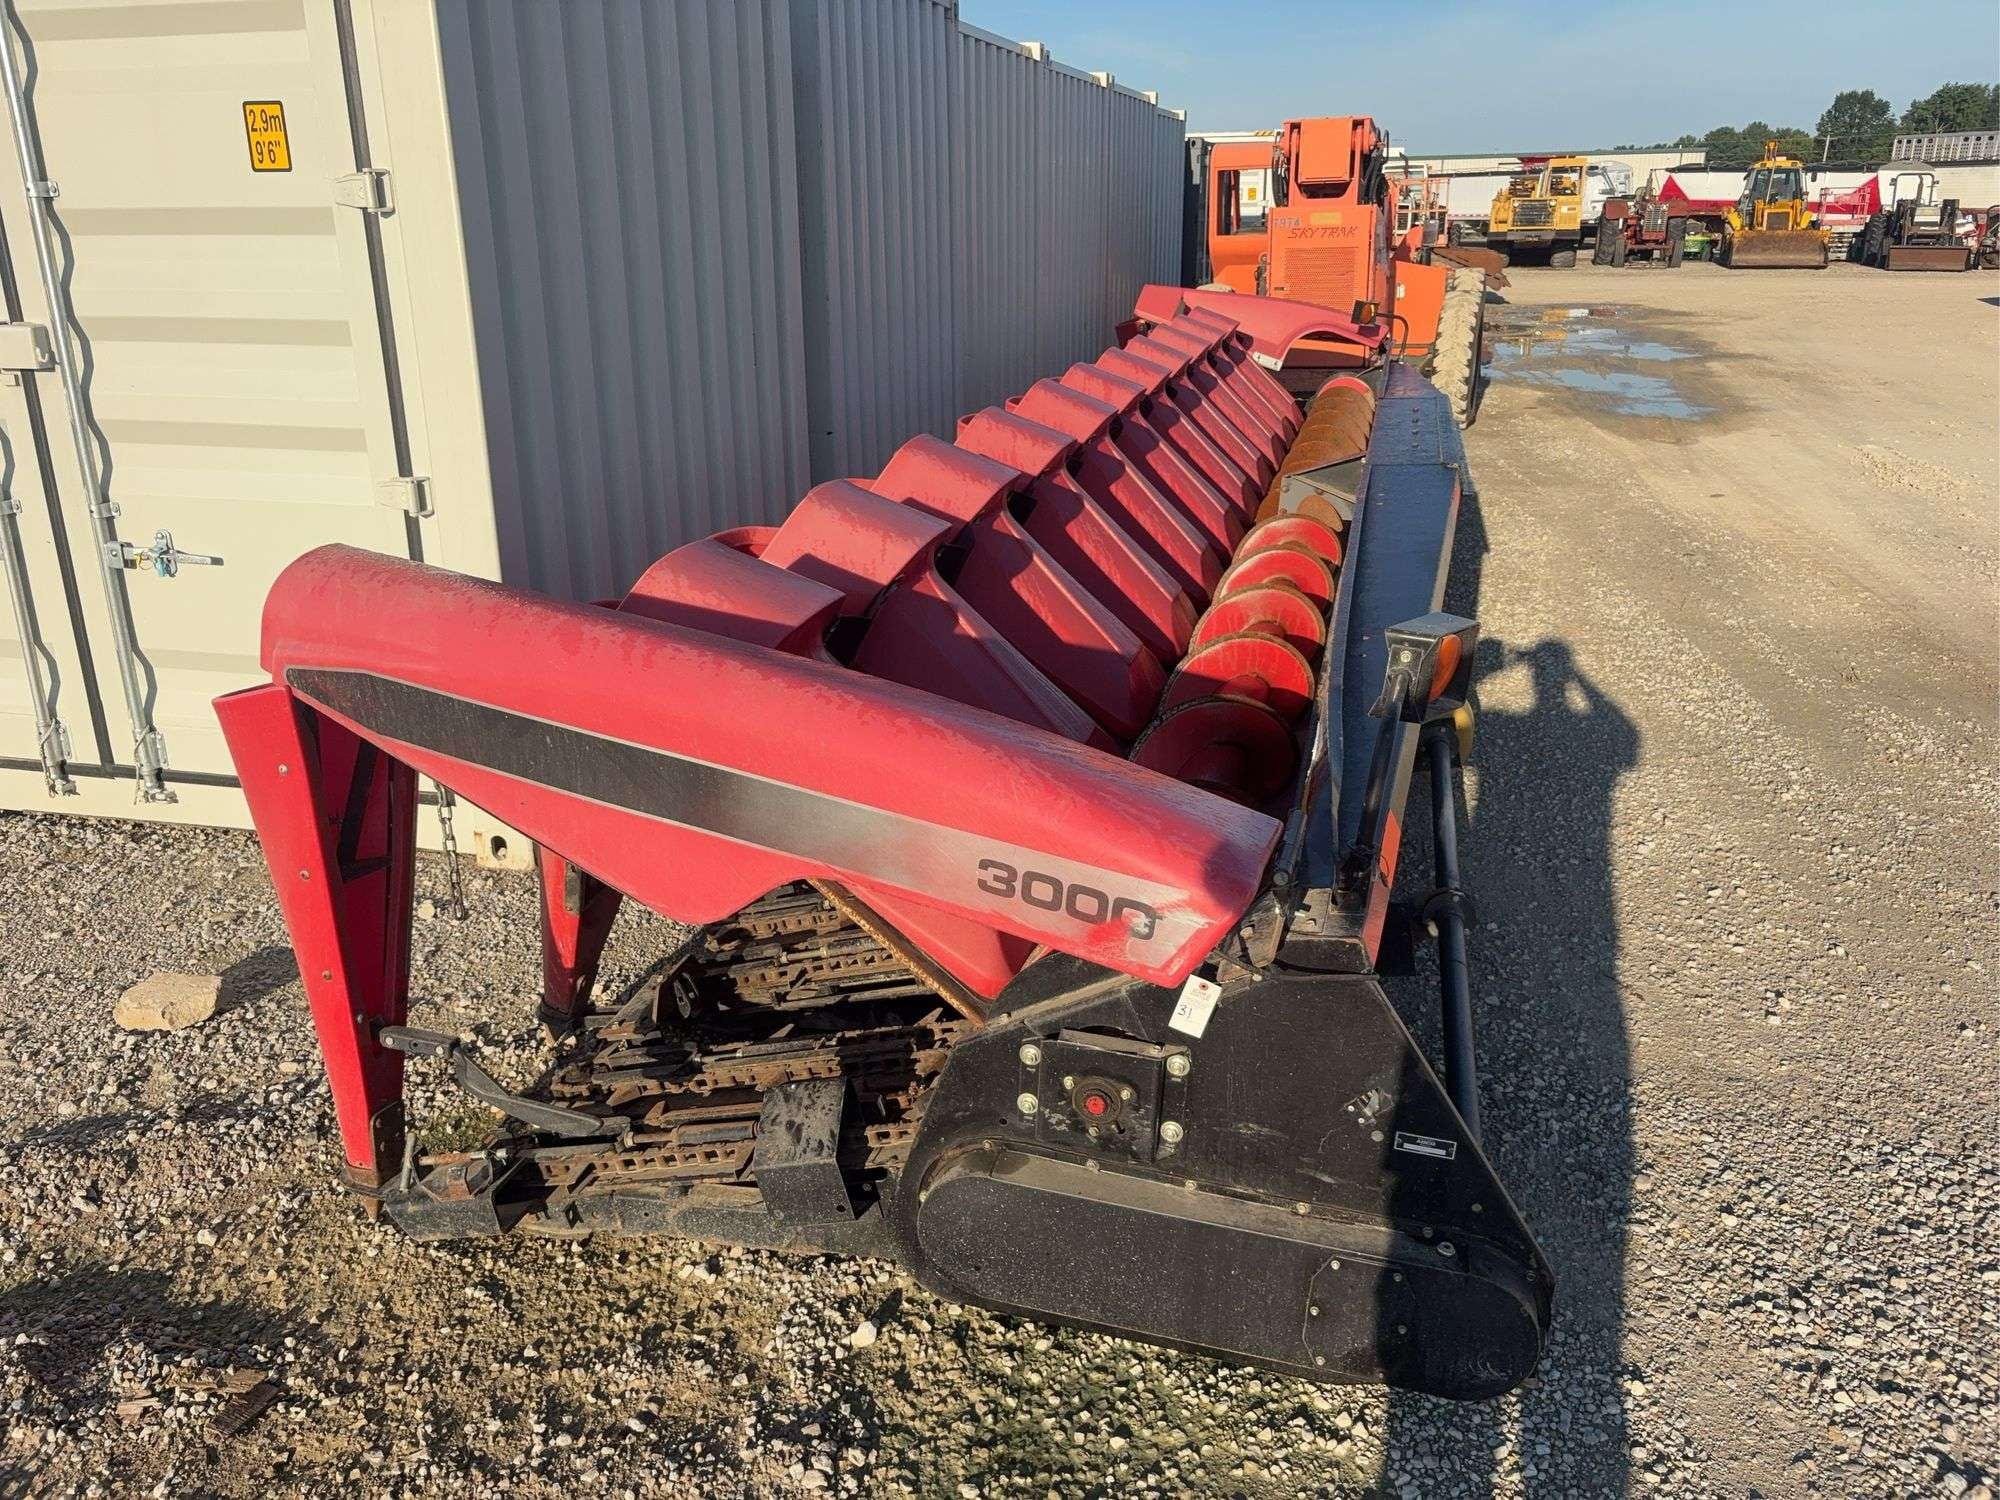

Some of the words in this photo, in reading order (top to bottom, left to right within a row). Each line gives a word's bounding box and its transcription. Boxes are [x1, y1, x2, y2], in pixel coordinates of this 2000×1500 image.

[249, 109, 282, 136] 2,9m
[255, 139, 281, 164] 9'6"
[977, 858, 1158, 940] 3000
